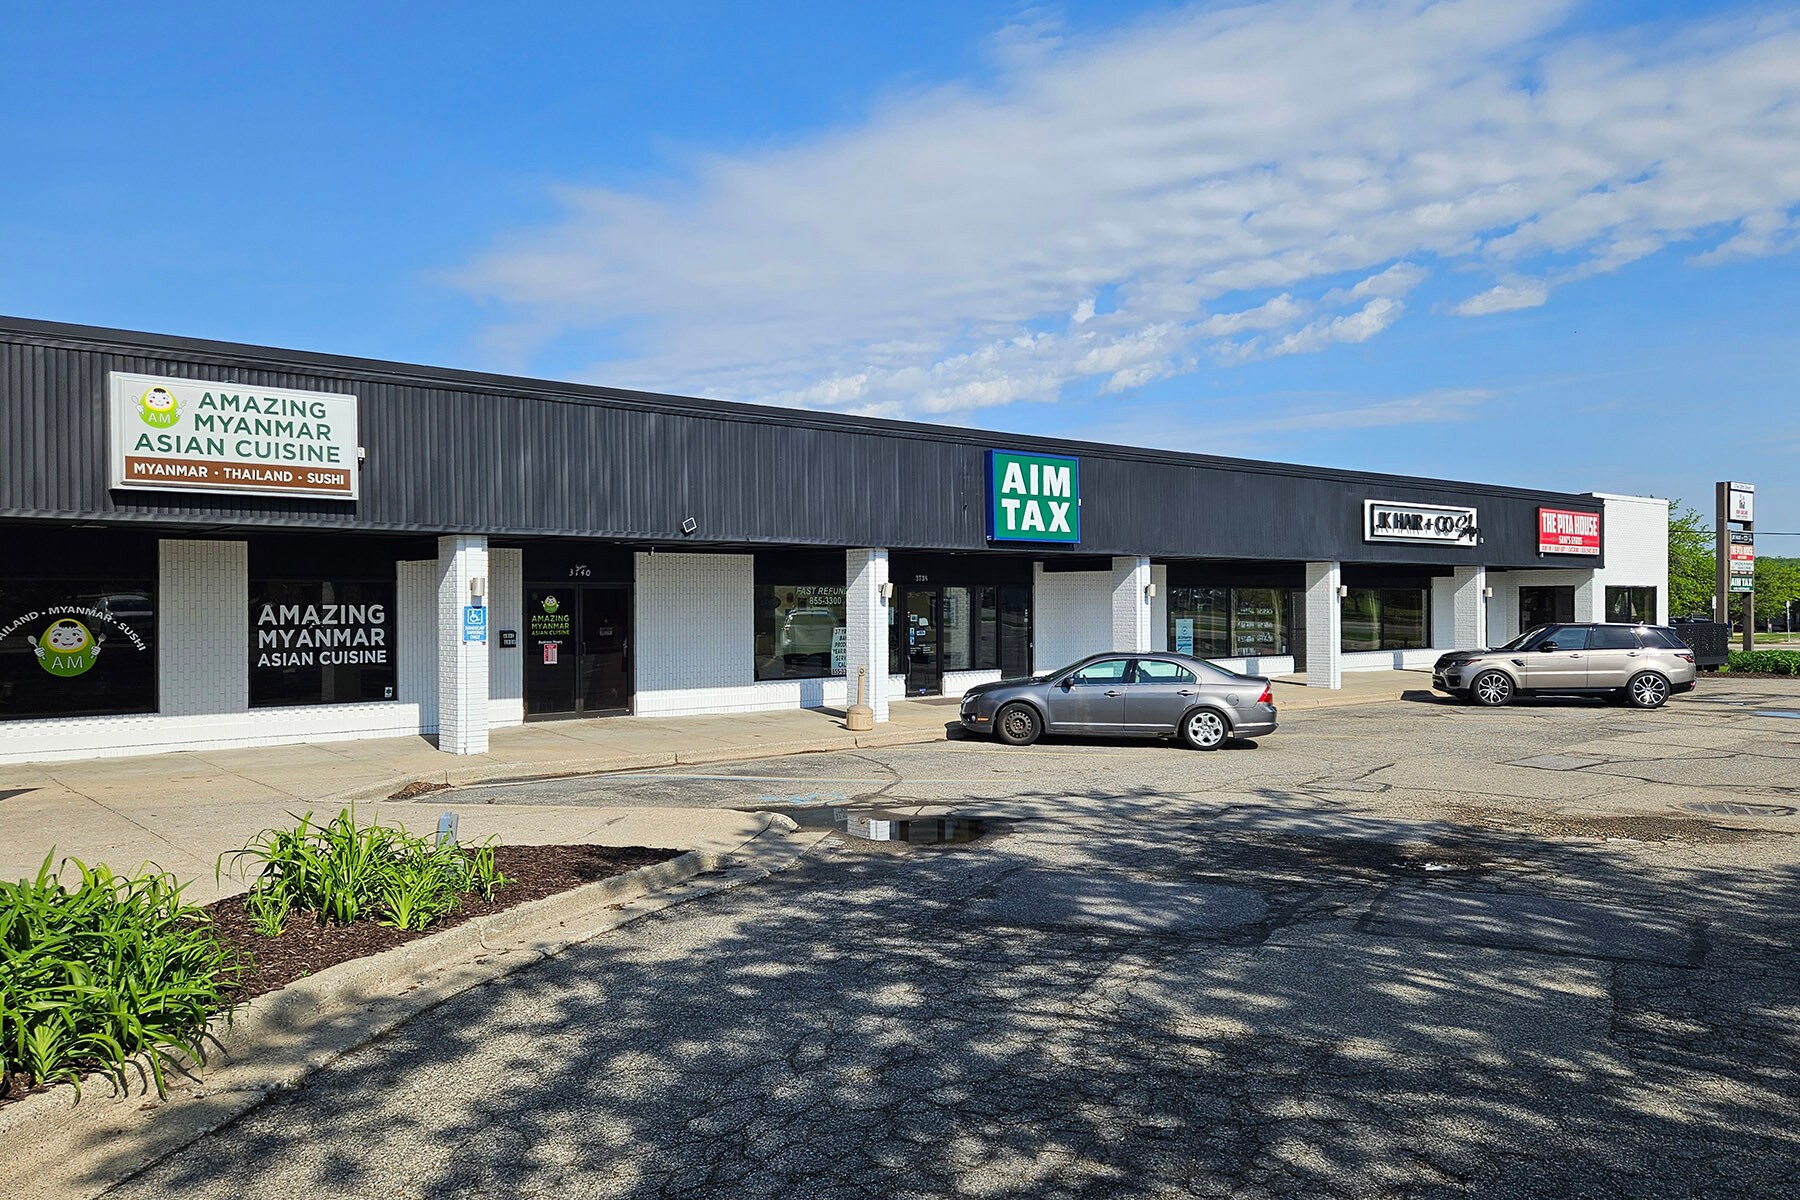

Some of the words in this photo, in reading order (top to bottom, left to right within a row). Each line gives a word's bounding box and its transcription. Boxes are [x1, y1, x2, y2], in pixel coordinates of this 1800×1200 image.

[198, 392, 326, 419] AMAZING
[148, 411, 171, 424] AM
[194, 413, 331, 441] MYANMAR
[134, 433, 225, 456] ASIAN
[236, 440, 340, 463] CUISINE
[134, 462, 208, 478] MYANMAR
[223, 467, 293, 482] THAILAND
[307, 473, 344, 485] SUSHI
[1001, 462, 1071, 497] AIM
[1001, 498, 1071, 533] TAX
[1376, 512, 1392, 529] JK
[1393, 512, 1423, 531] HAIR
[1435, 515, 1455, 532] CO
[1542, 512, 1556, 533] THE
[1557, 513, 1574, 534] PITA
[1574, 515, 1597, 536] HOUSE
[796, 586, 816, 595] FAST
[1731, 577, 1742, 586] AIM
[1742, 578, 1752, 587] TAX
[809, 596, 842, 605] 855-3300
[258, 604, 385, 625] AMAZING
[531, 614, 570, 622] AMAZING
[0, 611, 39, 641] AILAND
[48, 606, 113, 623] MYANMAR
[117, 622, 147, 652] SUSHI
[531, 622, 570, 630] MYANMAR
[258, 628, 385, 648] MYANMAR
[52, 655, 83, 669] AM
[258, 652, 314, 667] ASIAN
[320, 650, 387, 665] CUISINE
